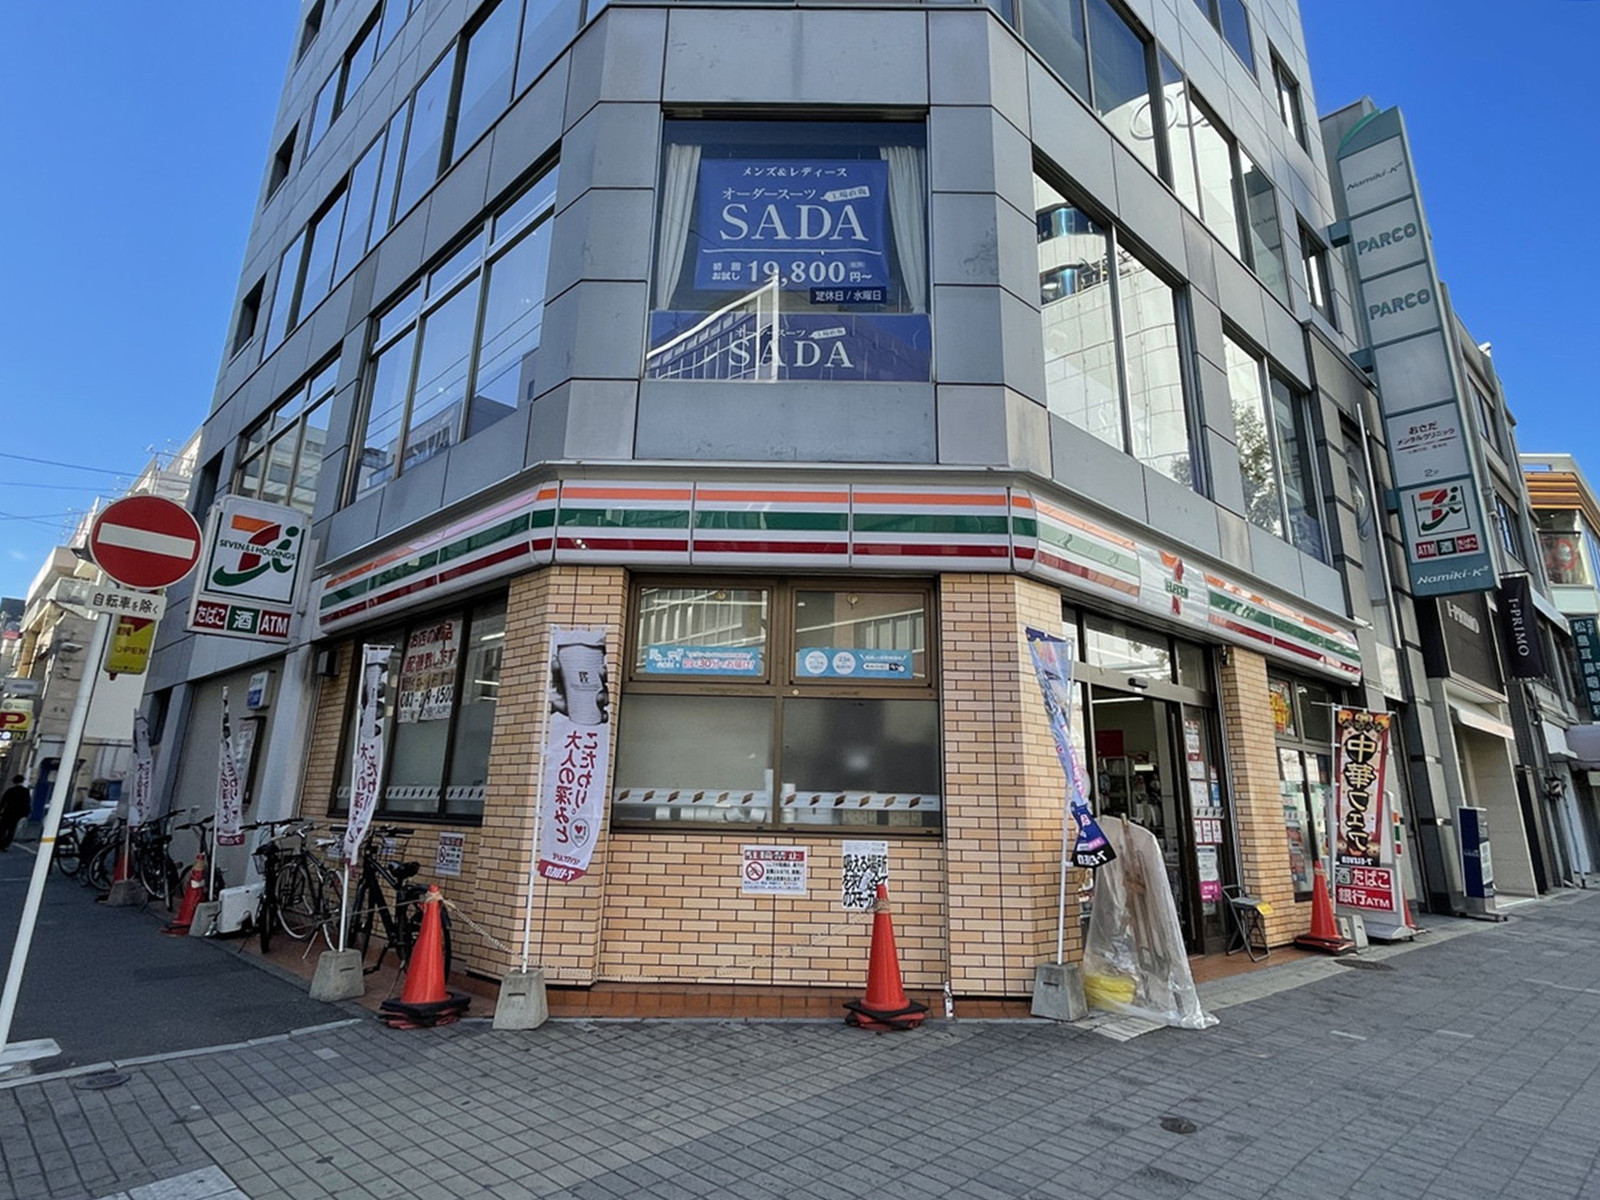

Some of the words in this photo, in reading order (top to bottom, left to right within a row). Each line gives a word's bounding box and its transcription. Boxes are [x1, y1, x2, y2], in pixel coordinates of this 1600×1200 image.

[722, 187, 817, 200] オーダースーツ
[720, 203, 869, 241] SADA
[1357, 222, 1417, 256] PARCO
[748, 260, 846, 286] 19,800
[815, 290, 843, 301] 定休日
[853, 290, 882, 301] 水曜日
[1368, 289, 1430, 320] PARCO
[729, 340, 854, 368] SADA
[1417, 542, 1436, 558] ATM
[93, 592, 159, 614] 自転車を除く
[196, 606, 226, 626] たばこ
[232, 610, 255, 629] 酒
[260, 615, 288, 634] ATM
[1509, 598, 1530, 656] I-PRIMO
[0, 712, 26, 728] P
[1353, 869, 1390, 889] たばこ
[1338, 887, 1391, 909] 銀行ATM
